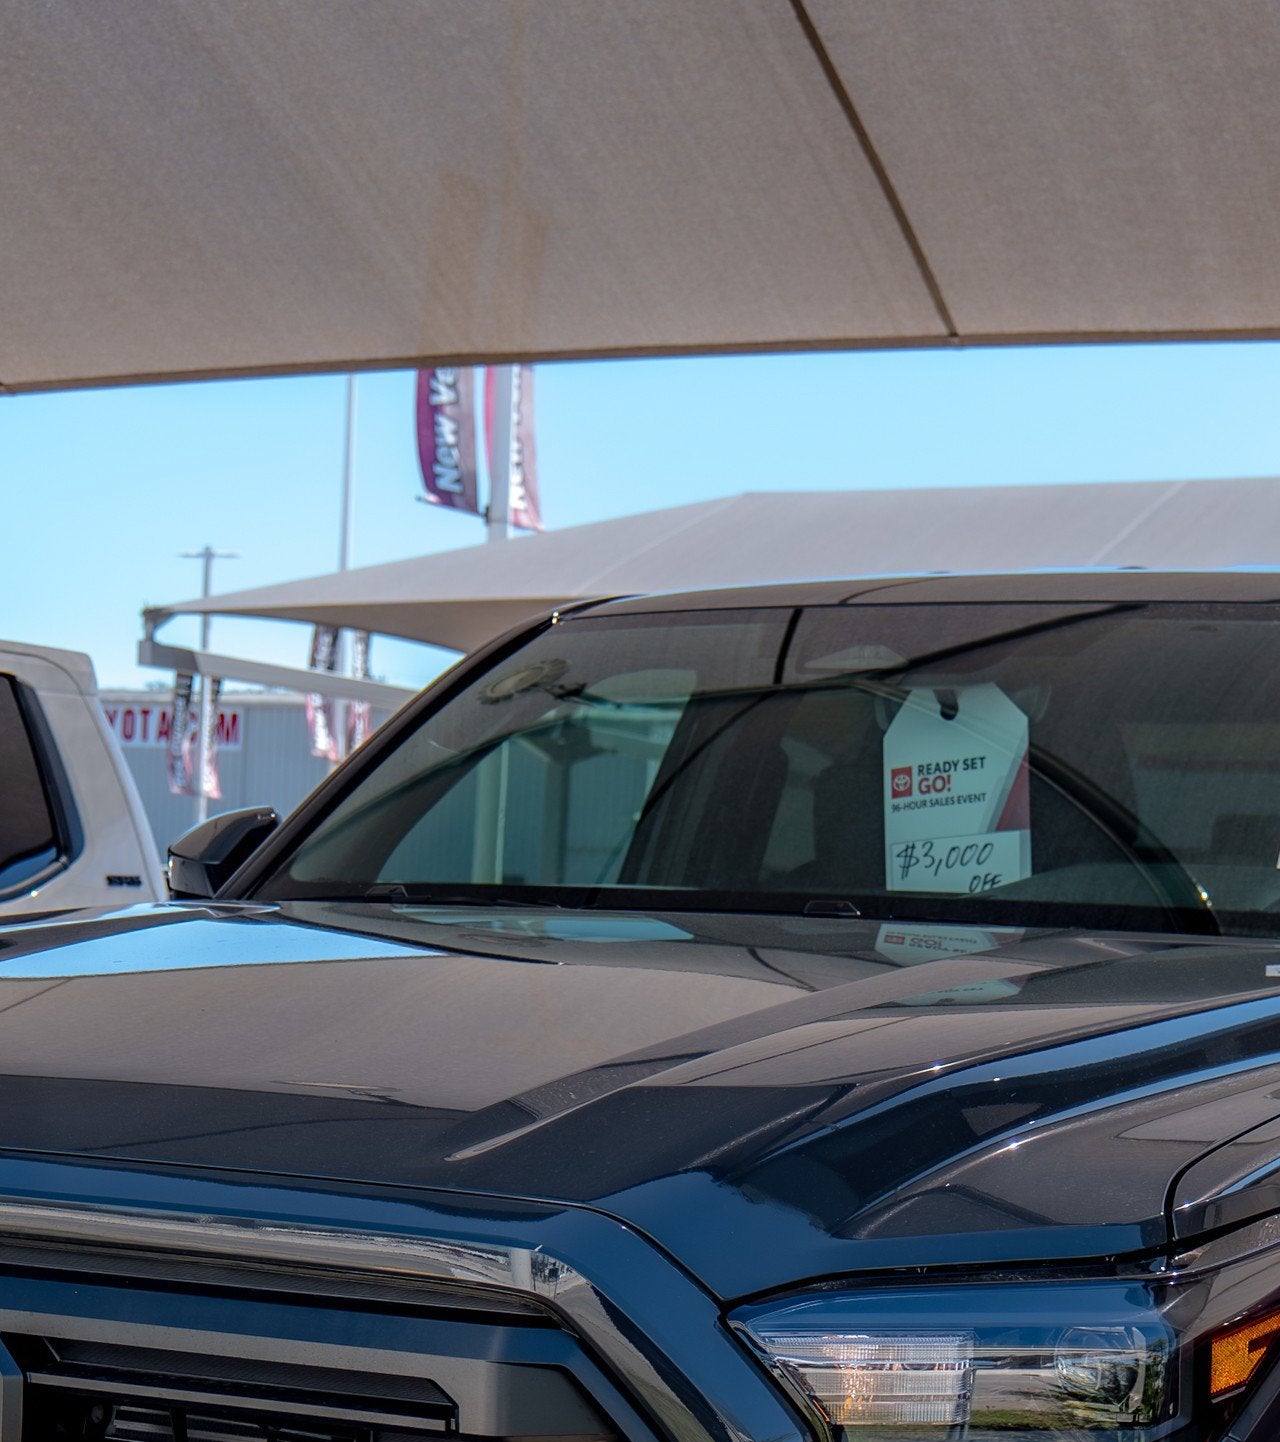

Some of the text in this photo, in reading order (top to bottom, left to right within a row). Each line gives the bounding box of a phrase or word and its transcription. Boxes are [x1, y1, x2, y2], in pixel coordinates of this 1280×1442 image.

[431, 411, 464, 494] New
[917, 757, 986, 776] READY SET
[918, 774, 952, 795] GO!
[891, 793, 987, 813] 96-HOUR SALES EVENT
[896, 841, 994, 880] $3,000
